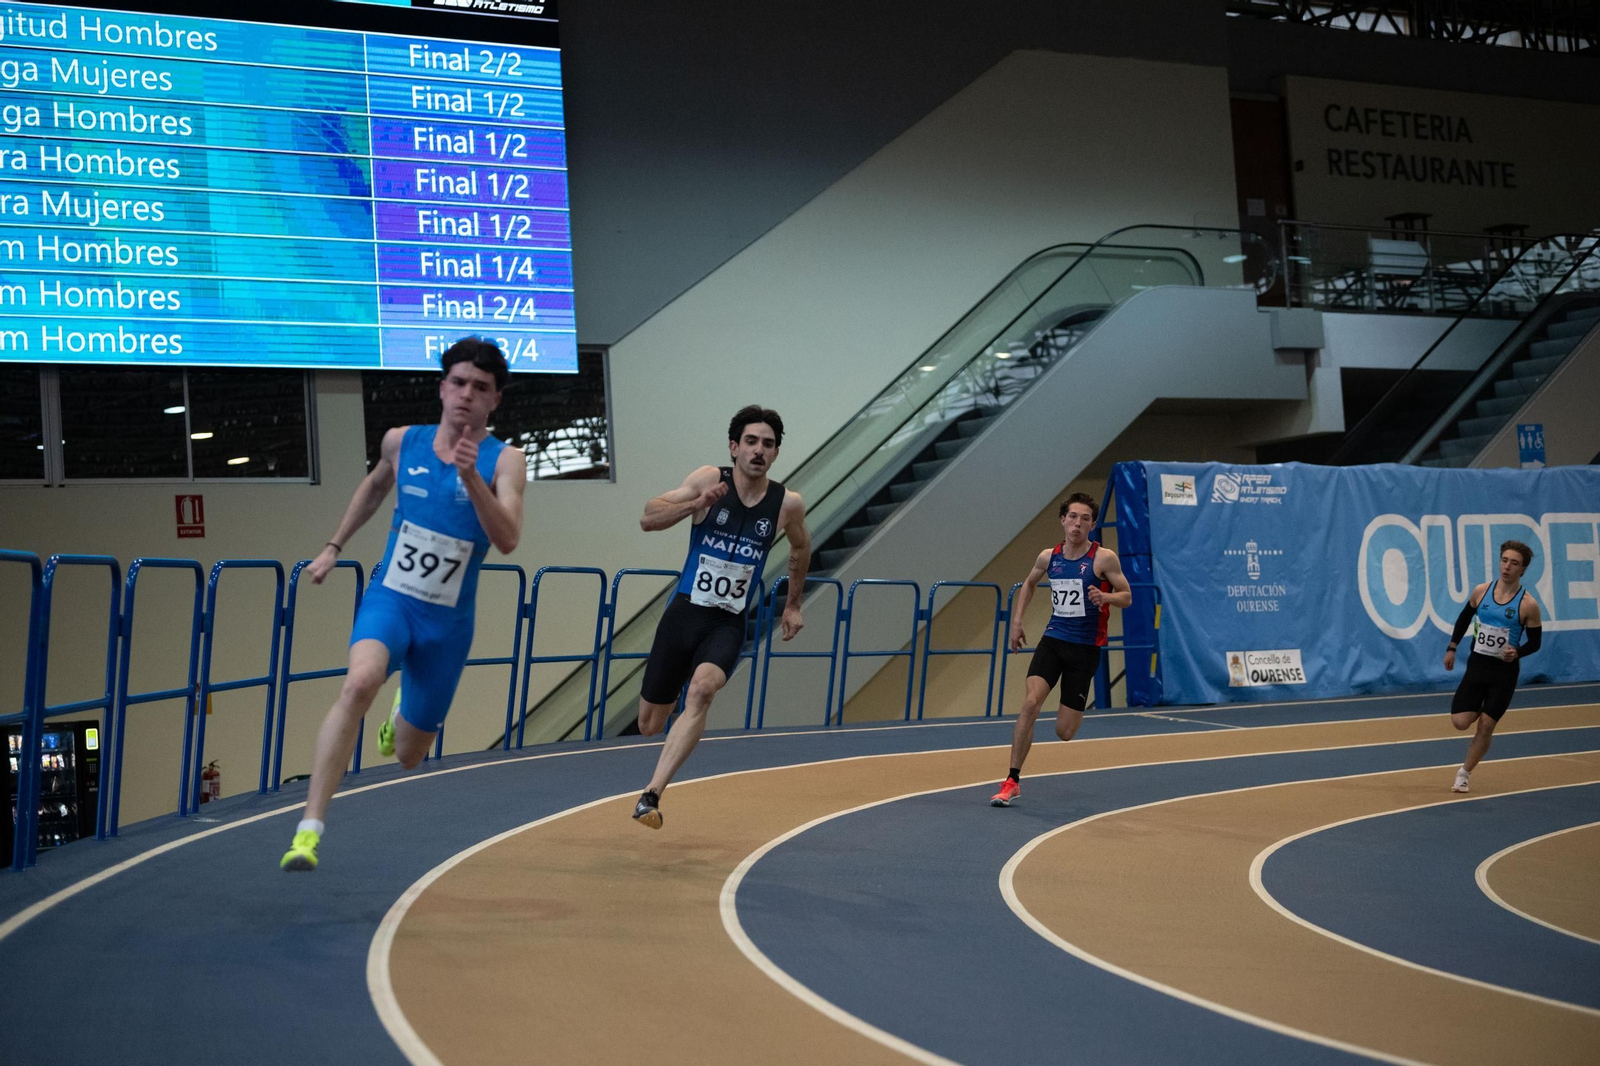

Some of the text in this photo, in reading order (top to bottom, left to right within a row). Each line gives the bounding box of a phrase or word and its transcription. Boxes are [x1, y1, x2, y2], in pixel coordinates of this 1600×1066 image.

[473, 0, 544, 14] ATLETISMO
[0, 9, 218, 51] itud Hombres
[1, 57, 173, 95] ga Mujeres
[409, 44, 523, 78] Final 2/2
[411, 85, 525, 118] Final 1/2
[2, 101, 193, 136] ga Hombres
[1324, 103, 1473, 143] CAFETERIA
[414, 127, 527, 159] Final 1/2
[0, 145, 180, 179] ra Hombres
[1327, 148, 1517, 189] RESTAURANTE
[416, 168, 530, 200] Final 1/2
[1, 190, 165, 227] ra Mujeres
[418, 210, 532, 241] Final 1/2
[38, 234, 179, 267] Hombres
[420, 251, 535, 282] Final 1/4
[40, 279, 181, 311] Hombres
[422, 293, 537, 323] Final 2/4
[0, 325, 183, 355] m Hombres
[496, 337, 539, 364] 3/4
[1240, 486, 1287, 495] ATLETISMO
[701, 535, 763, 561] NARÓN
[713, 529, 728, 538] CLUB
[397, 543, 461, 584] 397
[697, 571, 748, 599] 803
[1053, 590, 1081, 606] 872
[1227, 582, 1286, 597] DEPUTACIÓN
[1236, 600, 1280, 612] OURENSE
[1478, 632, 1507, 649] 859
[1248, 653, 1291, 665] Concello de
[1251, 668, 1304, 683] OURENSE
